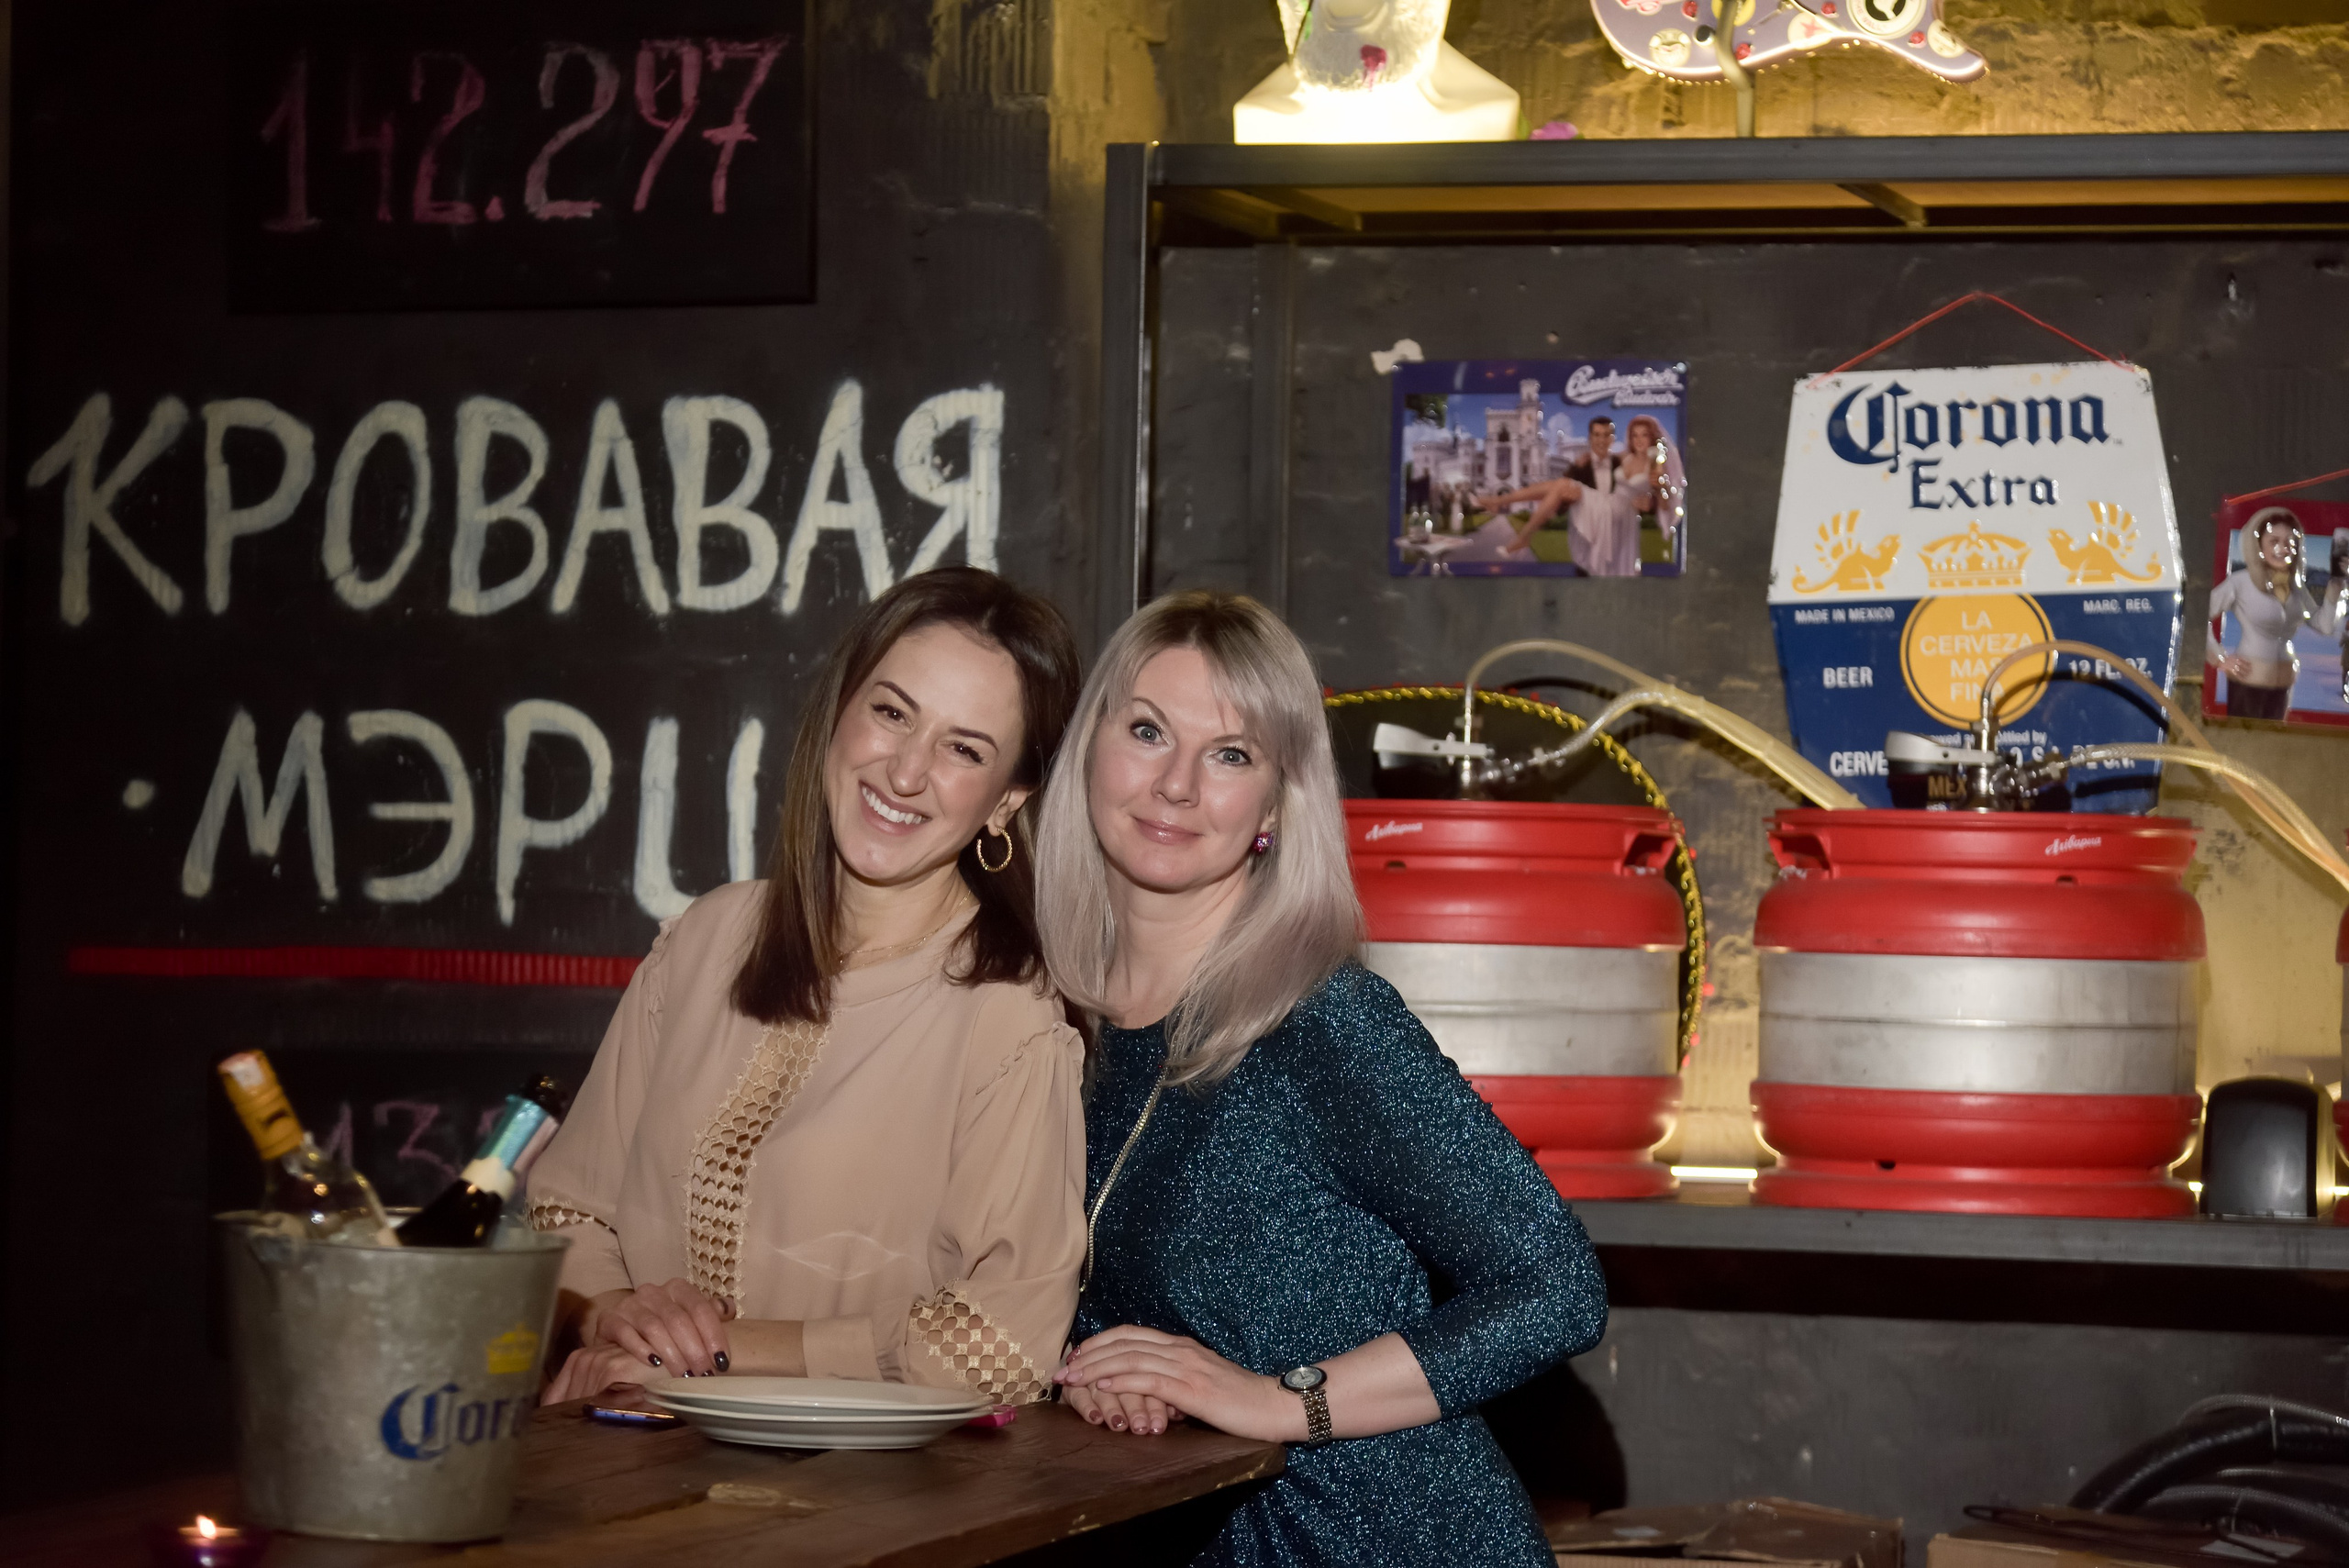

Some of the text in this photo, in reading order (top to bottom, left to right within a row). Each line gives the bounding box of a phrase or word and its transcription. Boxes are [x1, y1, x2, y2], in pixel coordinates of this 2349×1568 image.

[259, 33, 792, 233] 142.297
[1827, 381, 2110, 473] Corona
[1909, 457, 2061, 509] Extra
[26, 378, 1004, 627] КРОВАВАЯ
[1794, 606, 1896, 624] MADE IN MEXICO
[2126, 598, 2154, 613] REG.
[1962, 610, 1992, 630] LA
[1920, 632, 2034, 656] CERVEZA
[1822, 666, 1874, 688] BEER
[1830, 751, 1889, 777] CERVE
[380, 1383, 537, 1460] Cor
